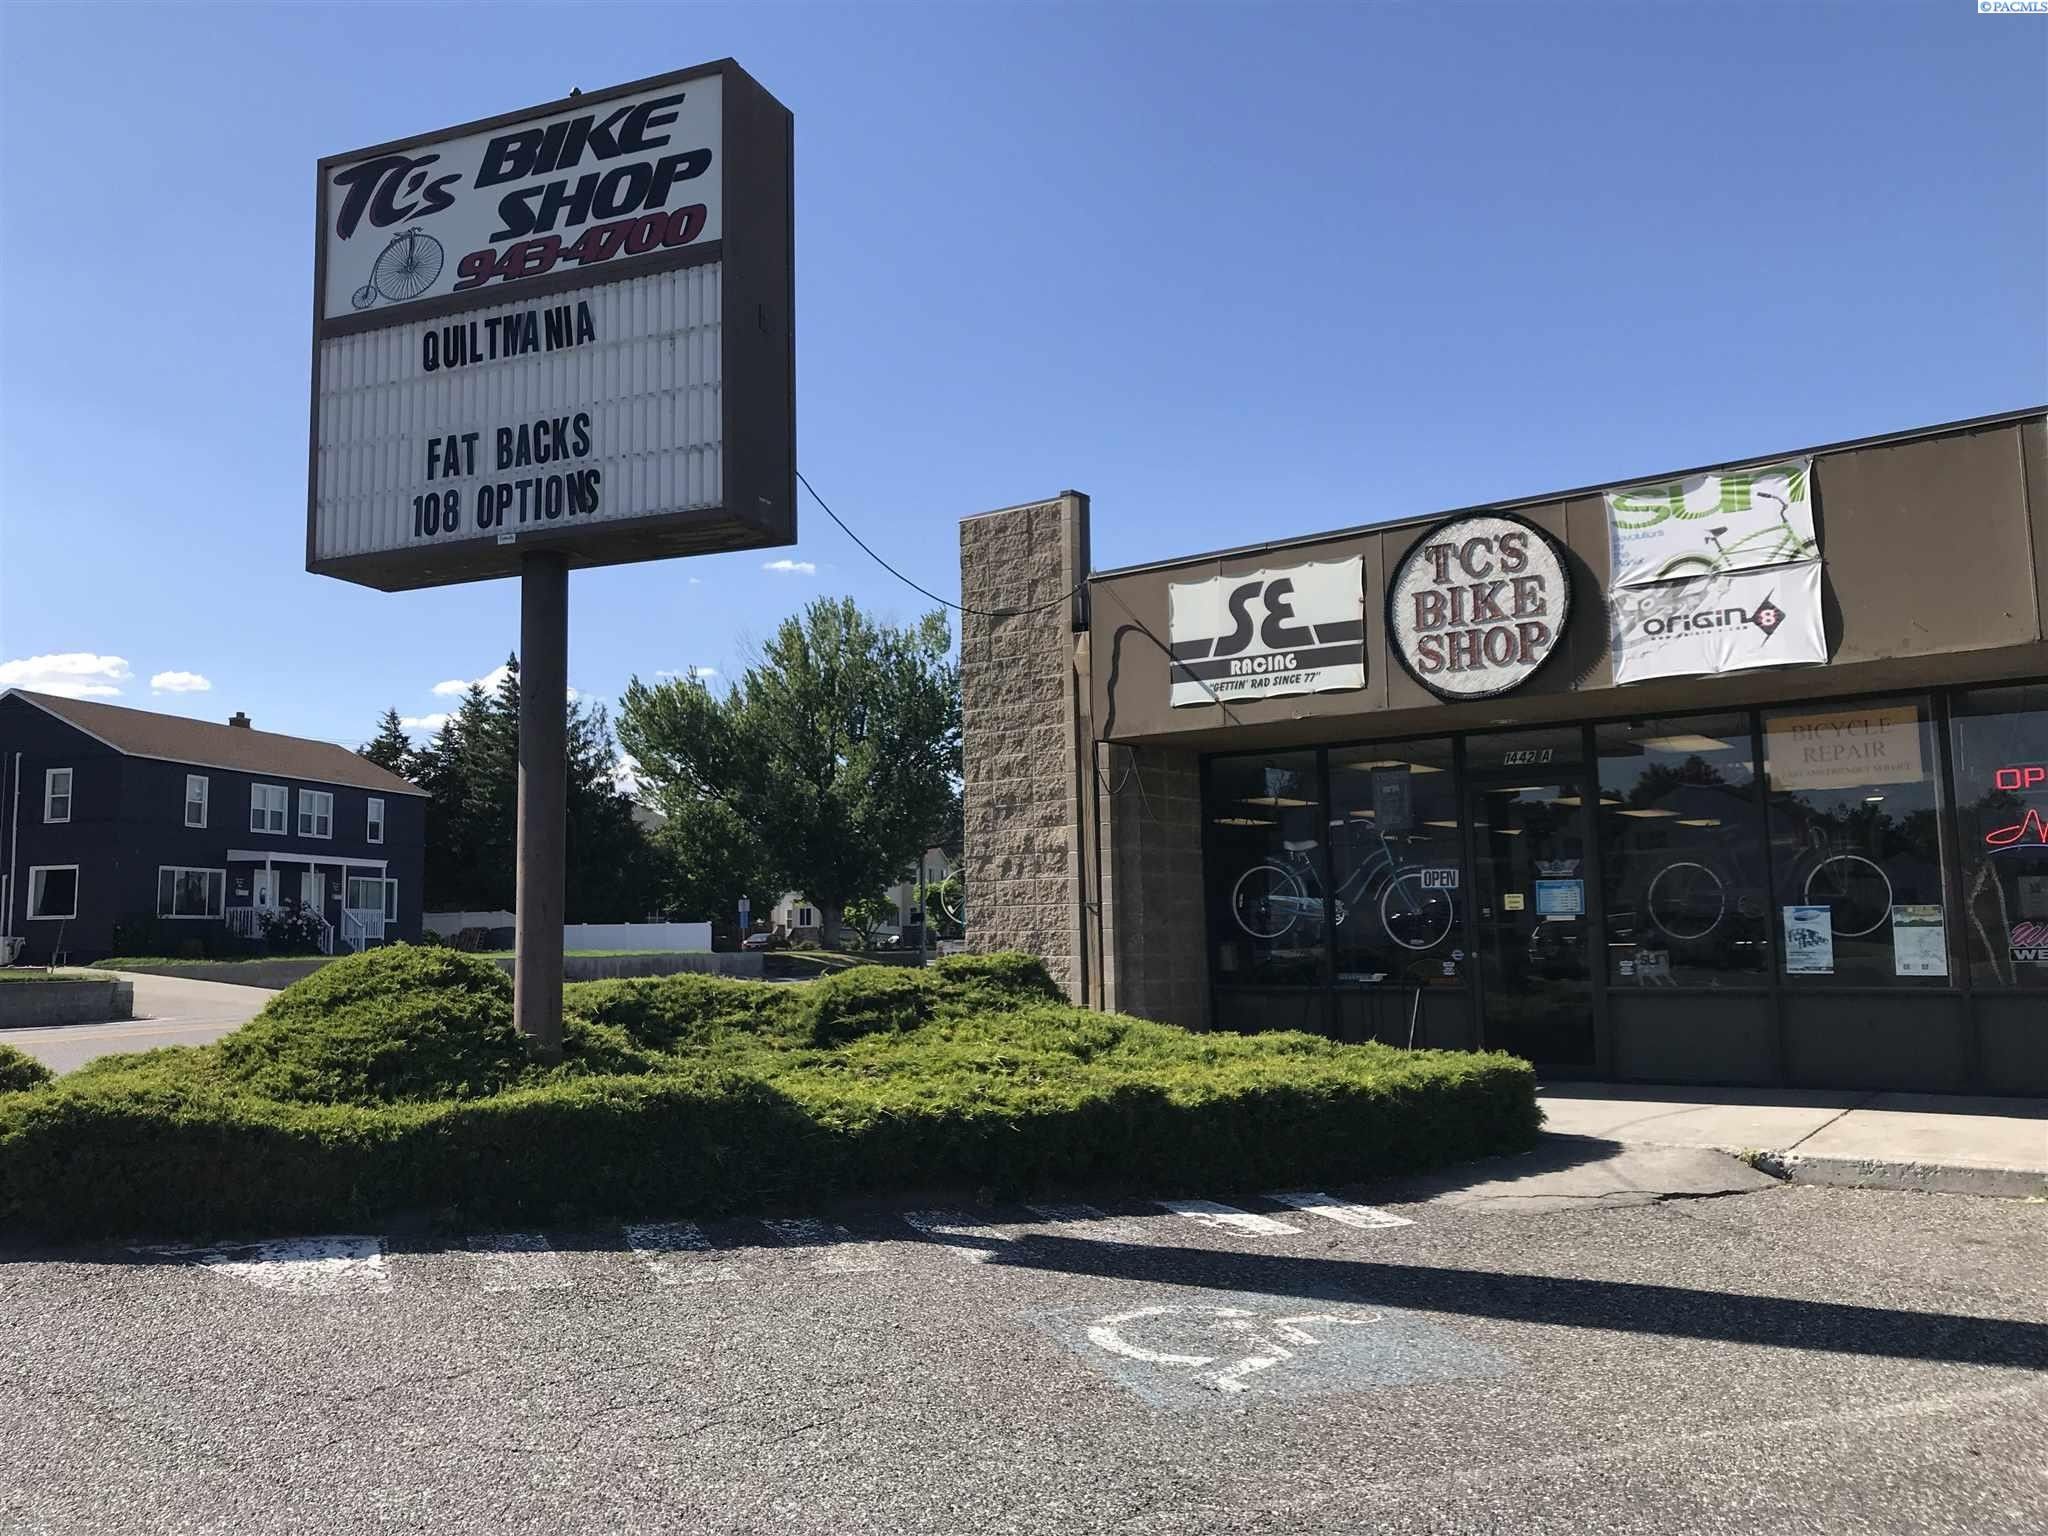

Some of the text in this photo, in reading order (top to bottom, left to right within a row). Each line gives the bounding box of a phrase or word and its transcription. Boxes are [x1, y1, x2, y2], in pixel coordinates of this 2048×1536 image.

[333, 92, 686, 241] TC's BIKE
[489, 147, 713, 244] SHOP
[453, 203, 707, 292] 943-4700
[422, 301, 596, 372] QUILTMANIA
[427, 412, 590, 480] FAT BACKS
[413, 468, 600, 537] 108 OPTIONS
[1425, 532, 1528, 585] TC'S
[1214, 577, 1315, 657] SE
[1411, 574, 1548, 633] BIKE
[1230, 652, 1297, 676] RACING
[1417, 620, 1553, 675] SHOP
[1251, 676, 1270, 689] RAD
[1273, 673, 1302, 686] SINCE
[1791, 716, 1894, 742] BICYCLE
[1803, 740, 1887, 763] REPAIR
[1423, 870, 1457, 888] OPEN
